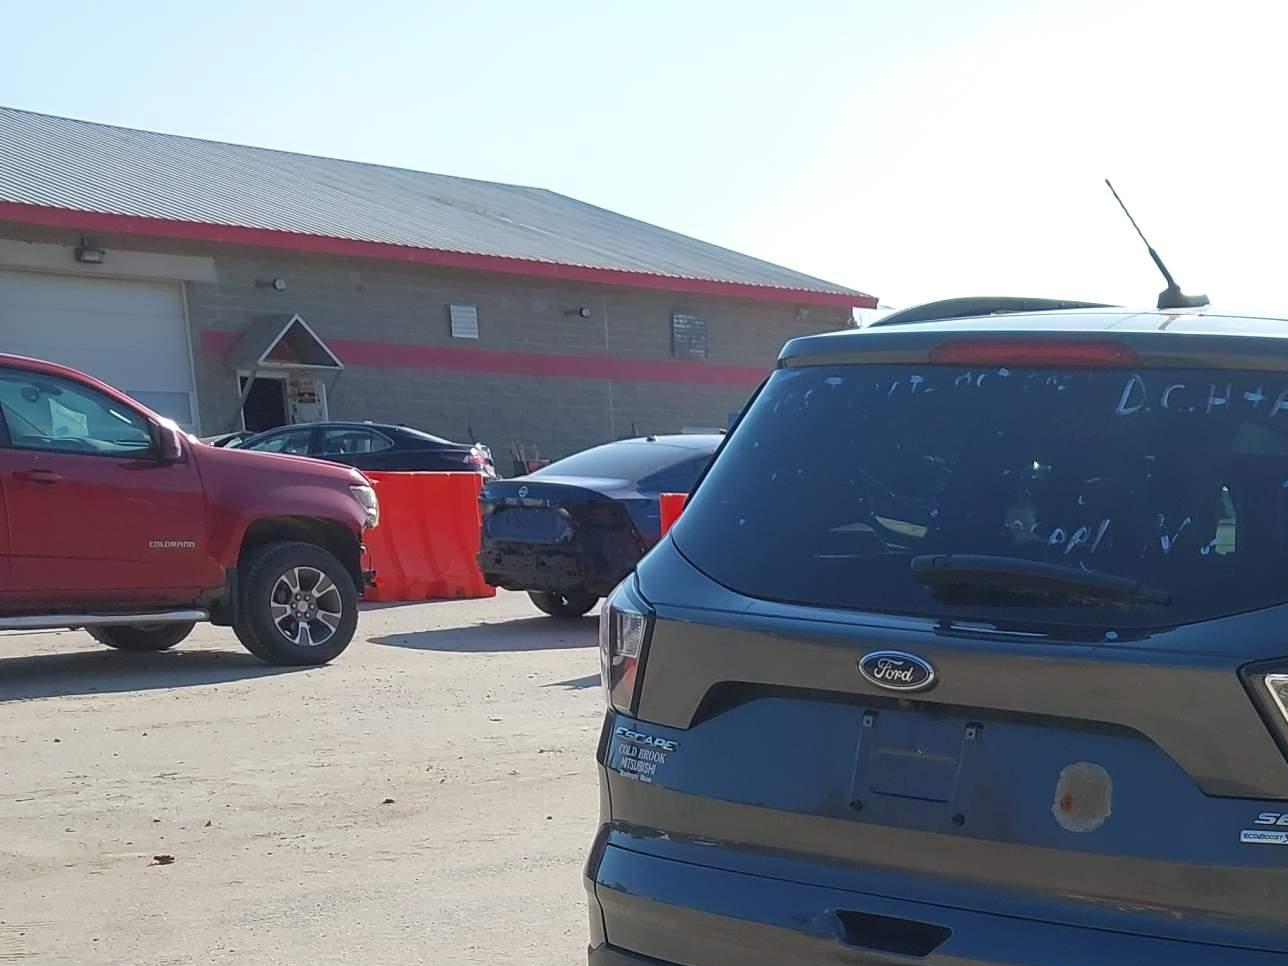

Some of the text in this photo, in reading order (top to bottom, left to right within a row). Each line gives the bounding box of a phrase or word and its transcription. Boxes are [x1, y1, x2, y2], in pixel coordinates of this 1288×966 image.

[873, 658, 914, 682] Ford
[615, 726, 679, 752] ESCAPE
[618, 743, 667, 765] COLD BROOK
[620, 756, 657, 775] MITSUBISHI
